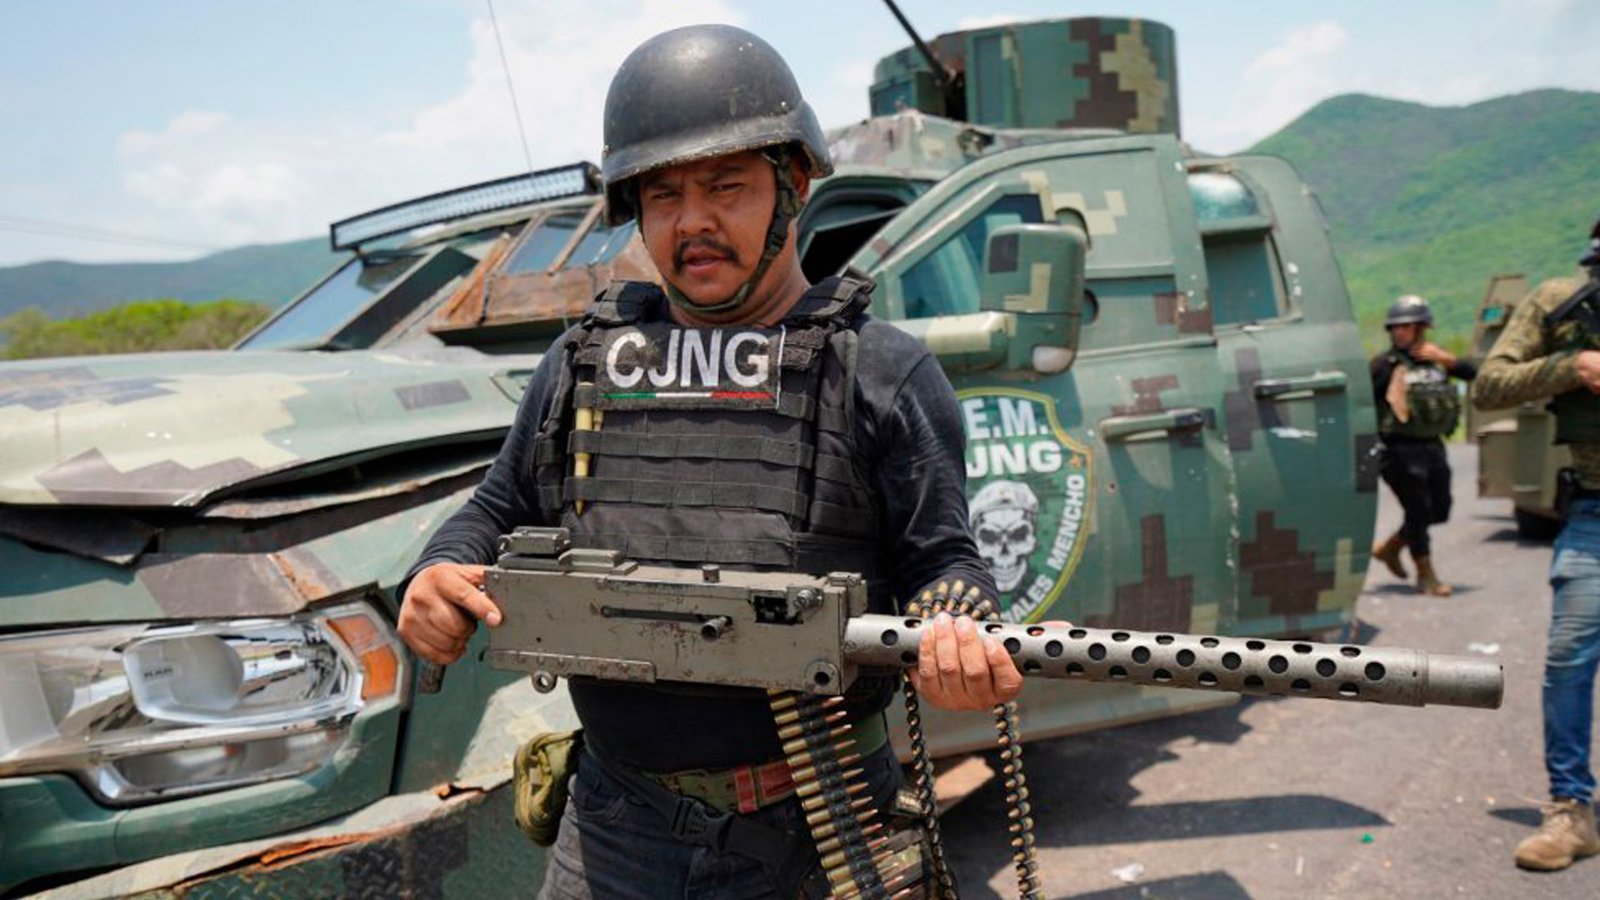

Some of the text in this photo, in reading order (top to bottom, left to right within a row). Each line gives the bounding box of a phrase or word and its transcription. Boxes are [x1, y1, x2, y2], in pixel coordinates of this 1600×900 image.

[606, 329, 769, 387] CJNG
[966, 441, 1062, 478] JNG
[1046, 474, 1085, 571] MENCHO
